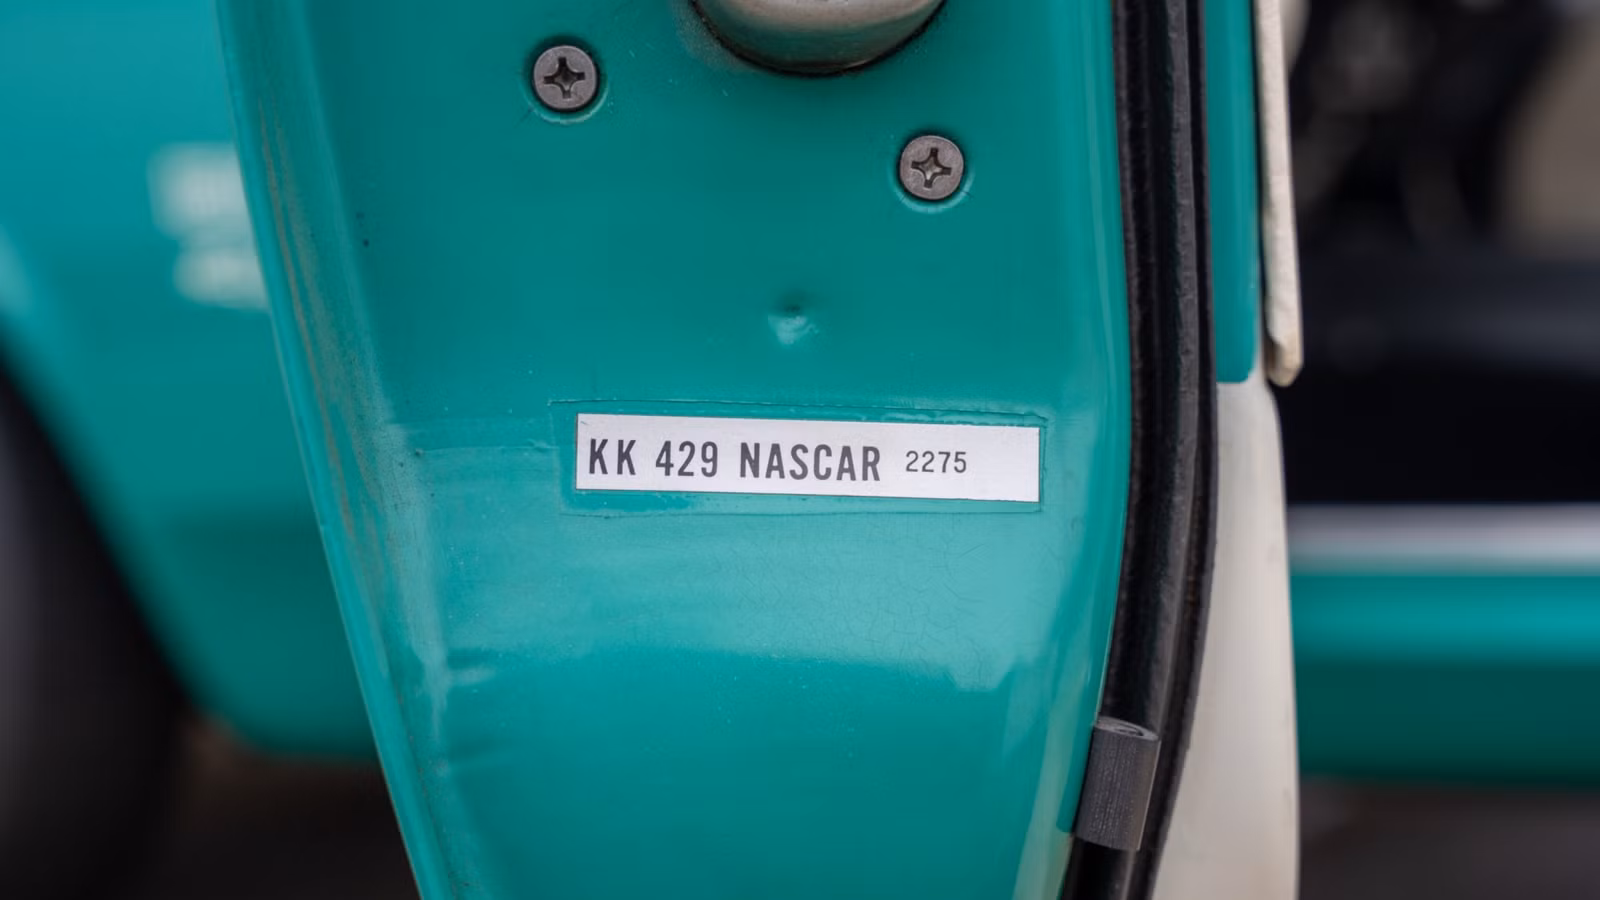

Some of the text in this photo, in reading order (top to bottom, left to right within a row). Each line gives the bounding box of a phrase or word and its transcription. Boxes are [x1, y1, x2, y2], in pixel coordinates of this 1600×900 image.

[588, 438, 968, 482] KK 429 NASCAR 2275
